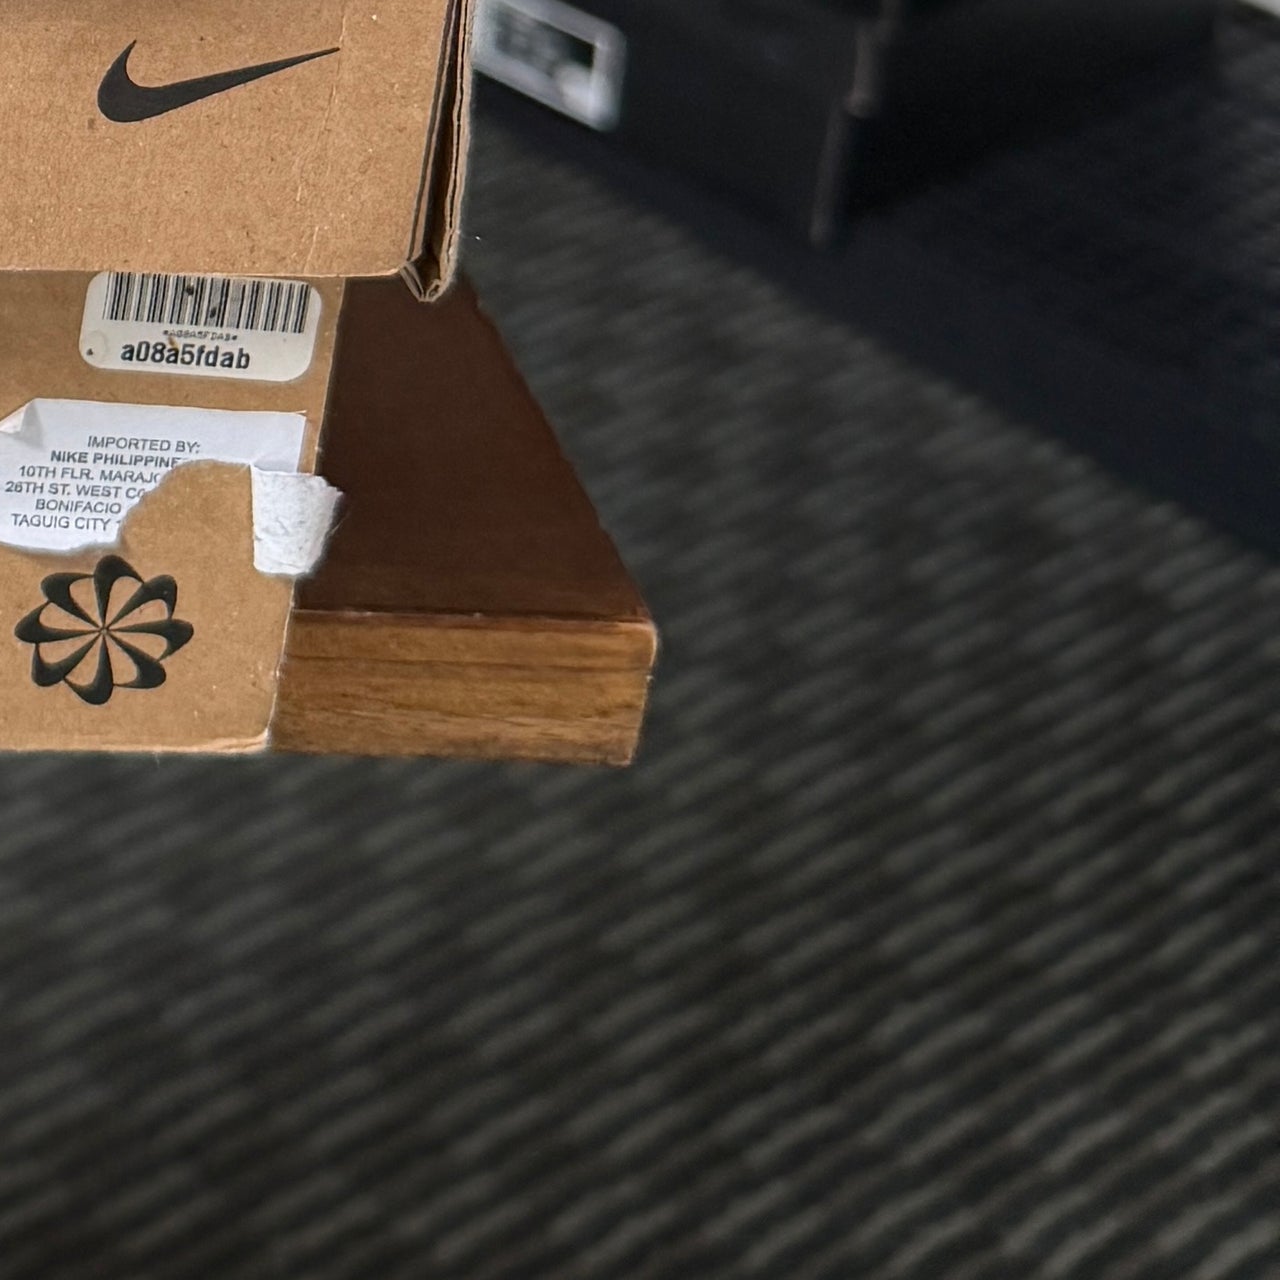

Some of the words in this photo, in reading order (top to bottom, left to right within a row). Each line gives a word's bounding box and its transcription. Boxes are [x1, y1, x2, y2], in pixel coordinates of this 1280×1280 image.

[120, 340, 251, 370] a08a5fdab
[87, 435, 171, 451] IMPORTED
[175, 440, 201, 454] BY:
[50, 450, 89, 464] NIKE
[92, 452, 186, 468] PHILIPPINE
[18, 465, 56, 478] 10TH
[60, 467, 94, 481] FLR.
[4, 480, 48, 494] 26TH
[48, 483, 71, 496] ST.
[76, 485, 123, 498] WEST
[35, 498, 122, 514] BONIFACIO
[10, 513, 70, 529] TAGUIG
[74, 516, 111, 531] CITY
